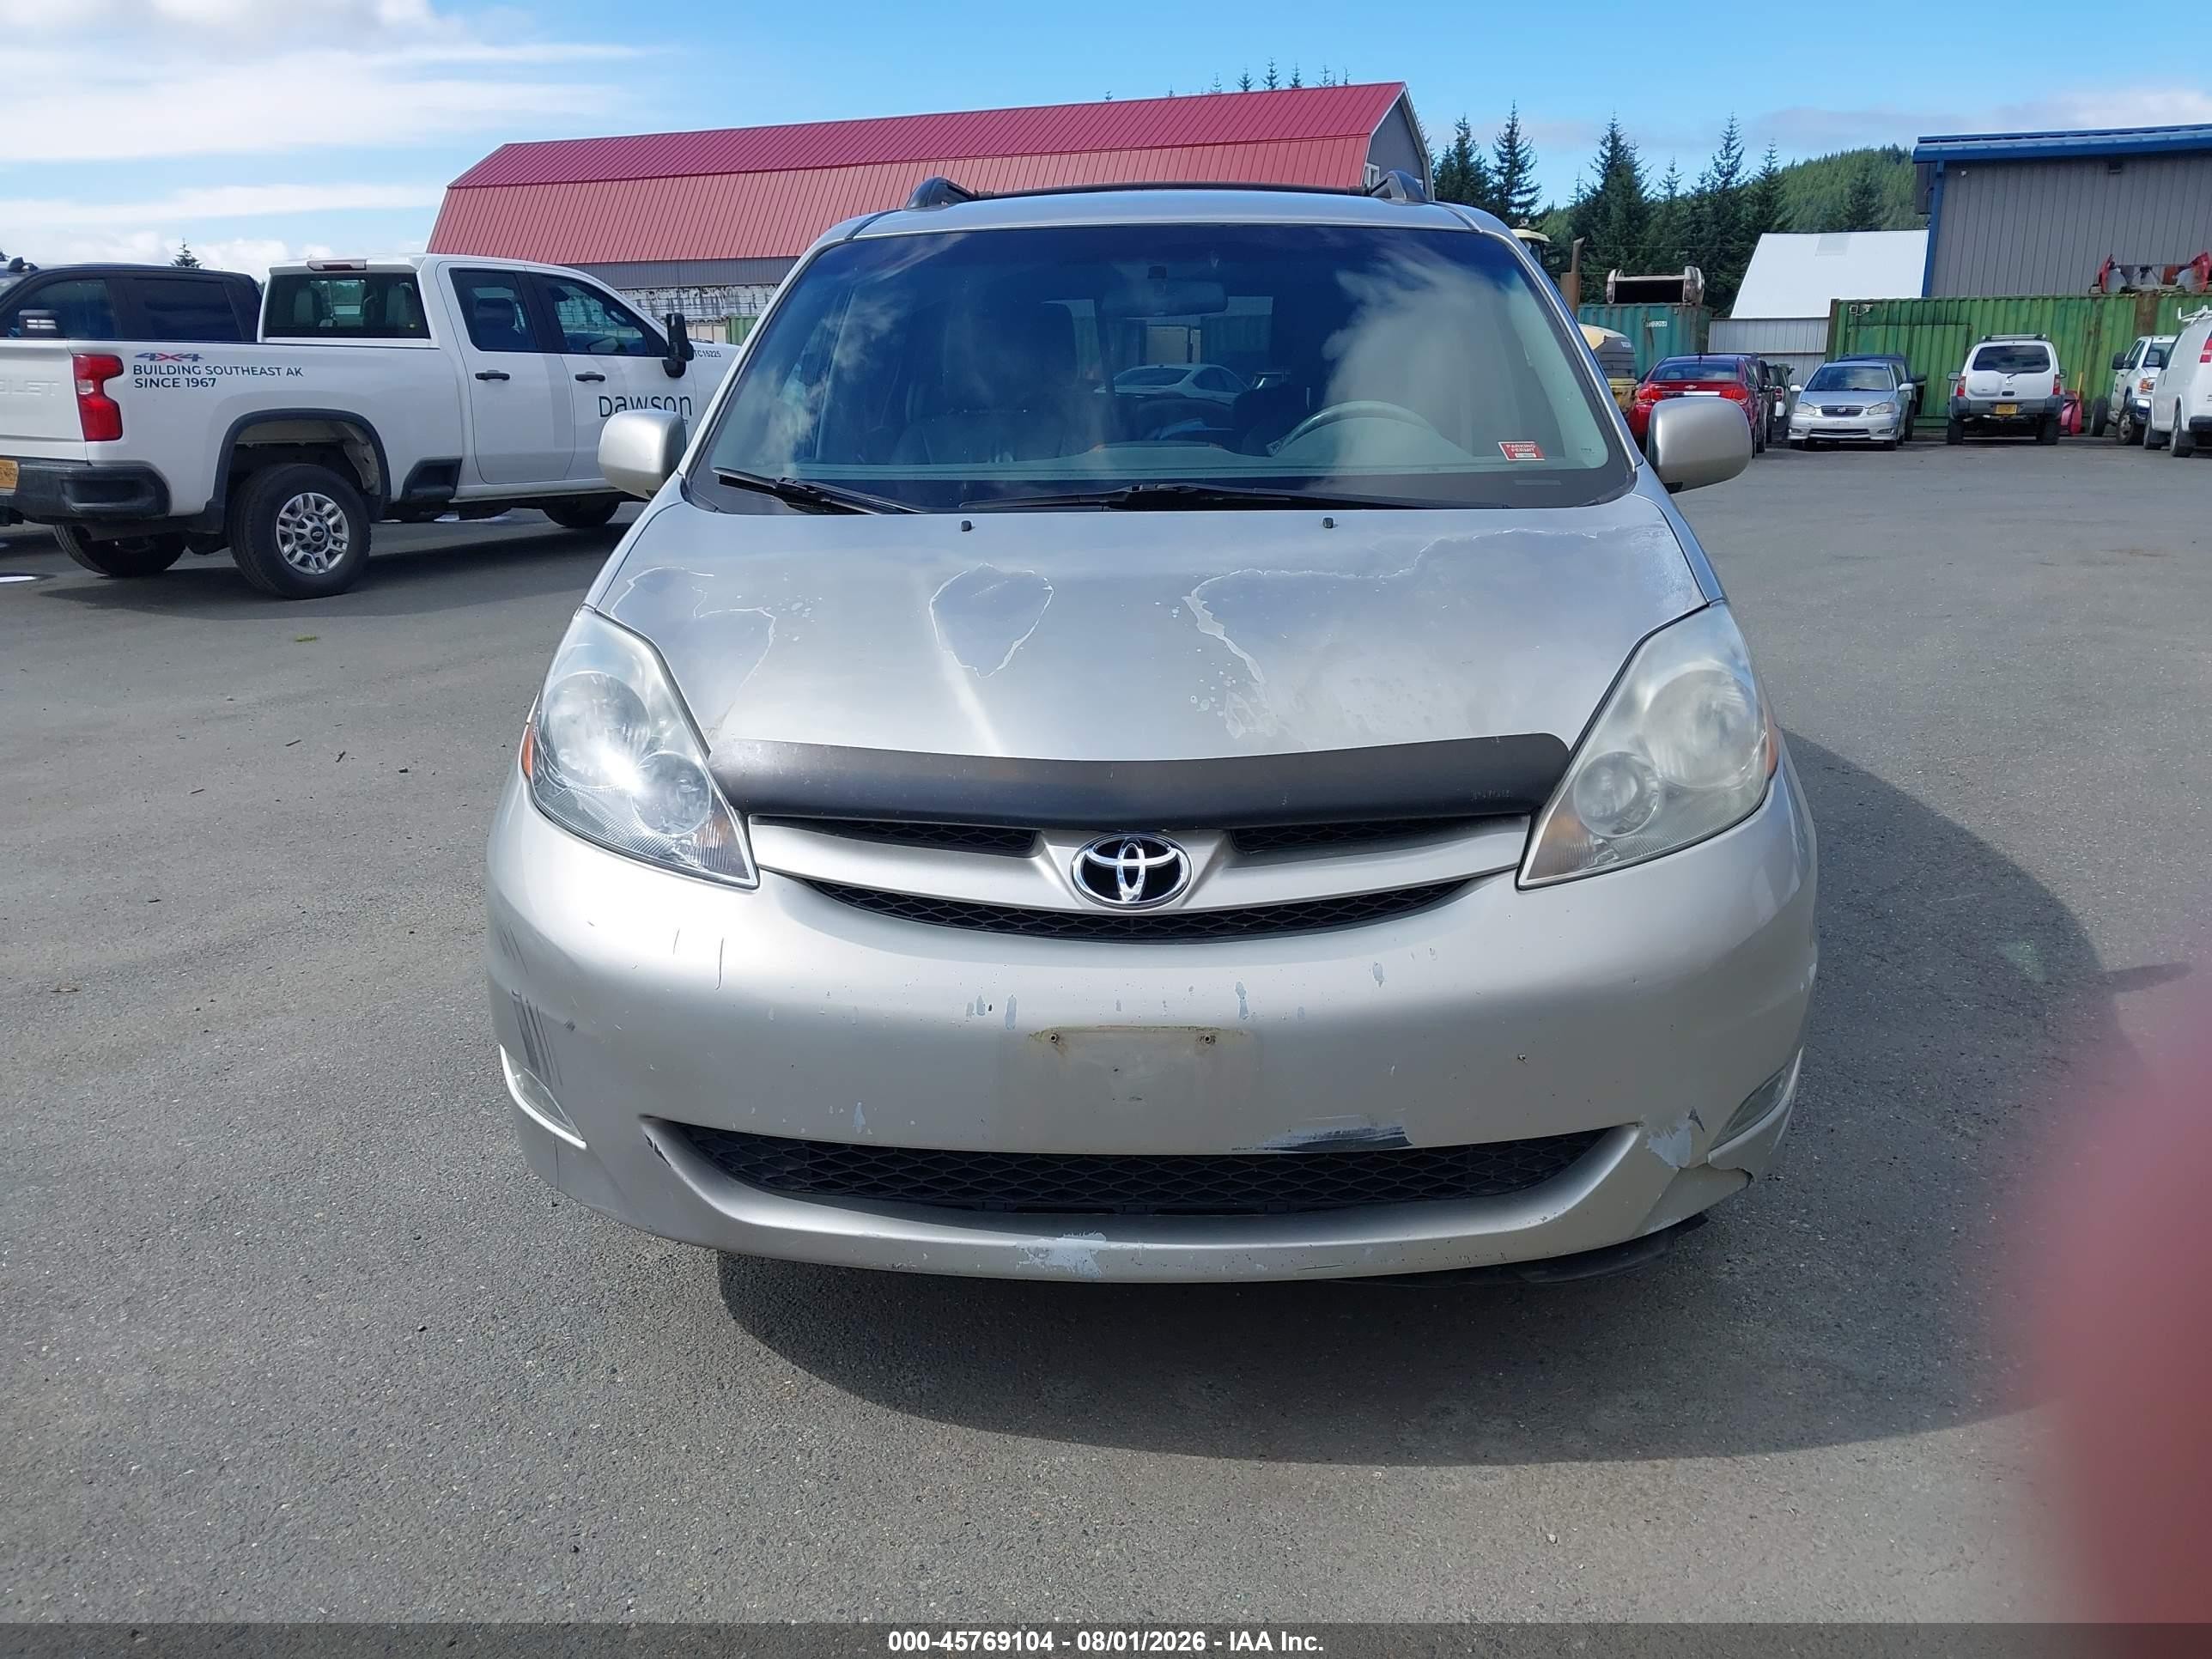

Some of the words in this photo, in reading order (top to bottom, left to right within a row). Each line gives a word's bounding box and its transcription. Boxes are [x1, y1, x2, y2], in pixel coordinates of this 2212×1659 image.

[133, 364, 202, 375] BUILDING
[205, 365, 283, 376] SOUTHEAST
[286, 367, 304, 377] AK
[134, 378, 181, 388] SINCE
[185, 378, 216, 388] 1967
